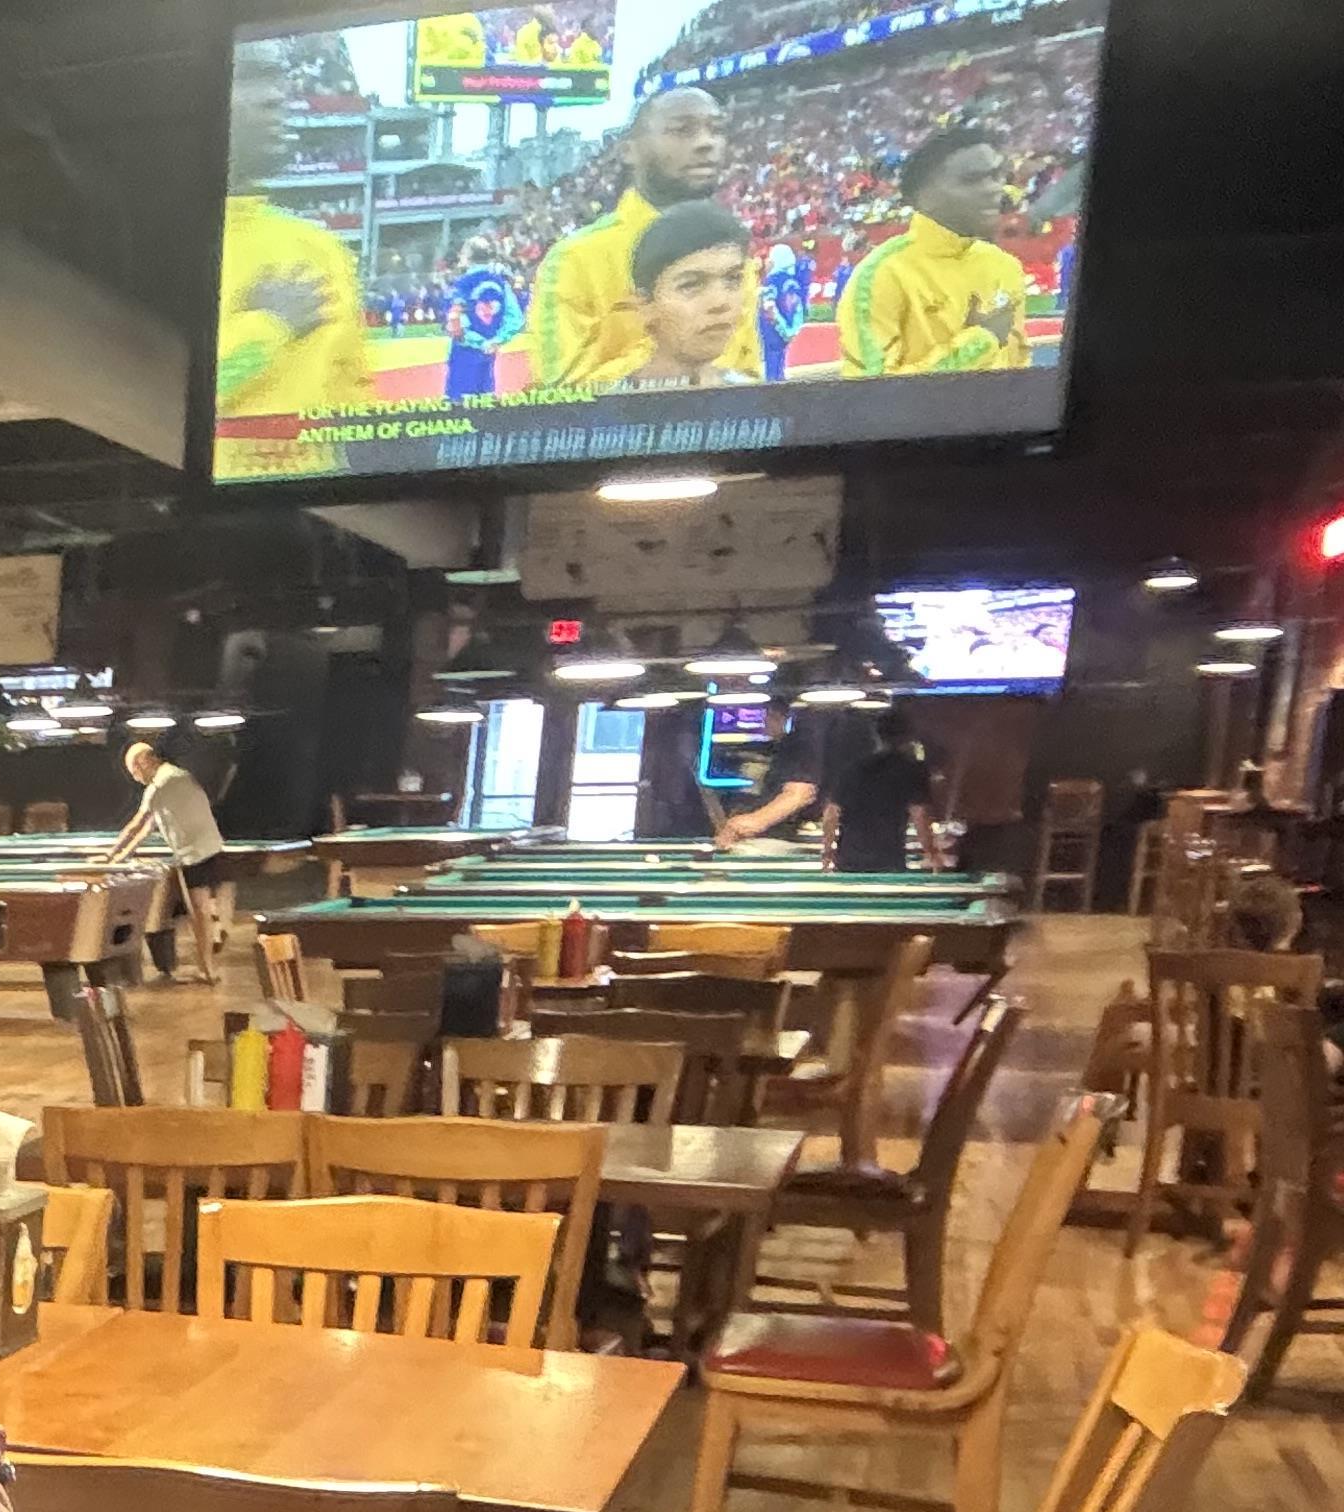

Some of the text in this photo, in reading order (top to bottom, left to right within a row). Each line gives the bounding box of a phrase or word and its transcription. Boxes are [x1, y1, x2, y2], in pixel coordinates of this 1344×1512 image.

[374, 397, 451, 417] PLAYING
[460, 393, 501, 411] THE
[502, 386, 600, 408] NATIONAL
[296, 424, 374, 446] ANTHEM
[376, 422, 403, 441] OF
